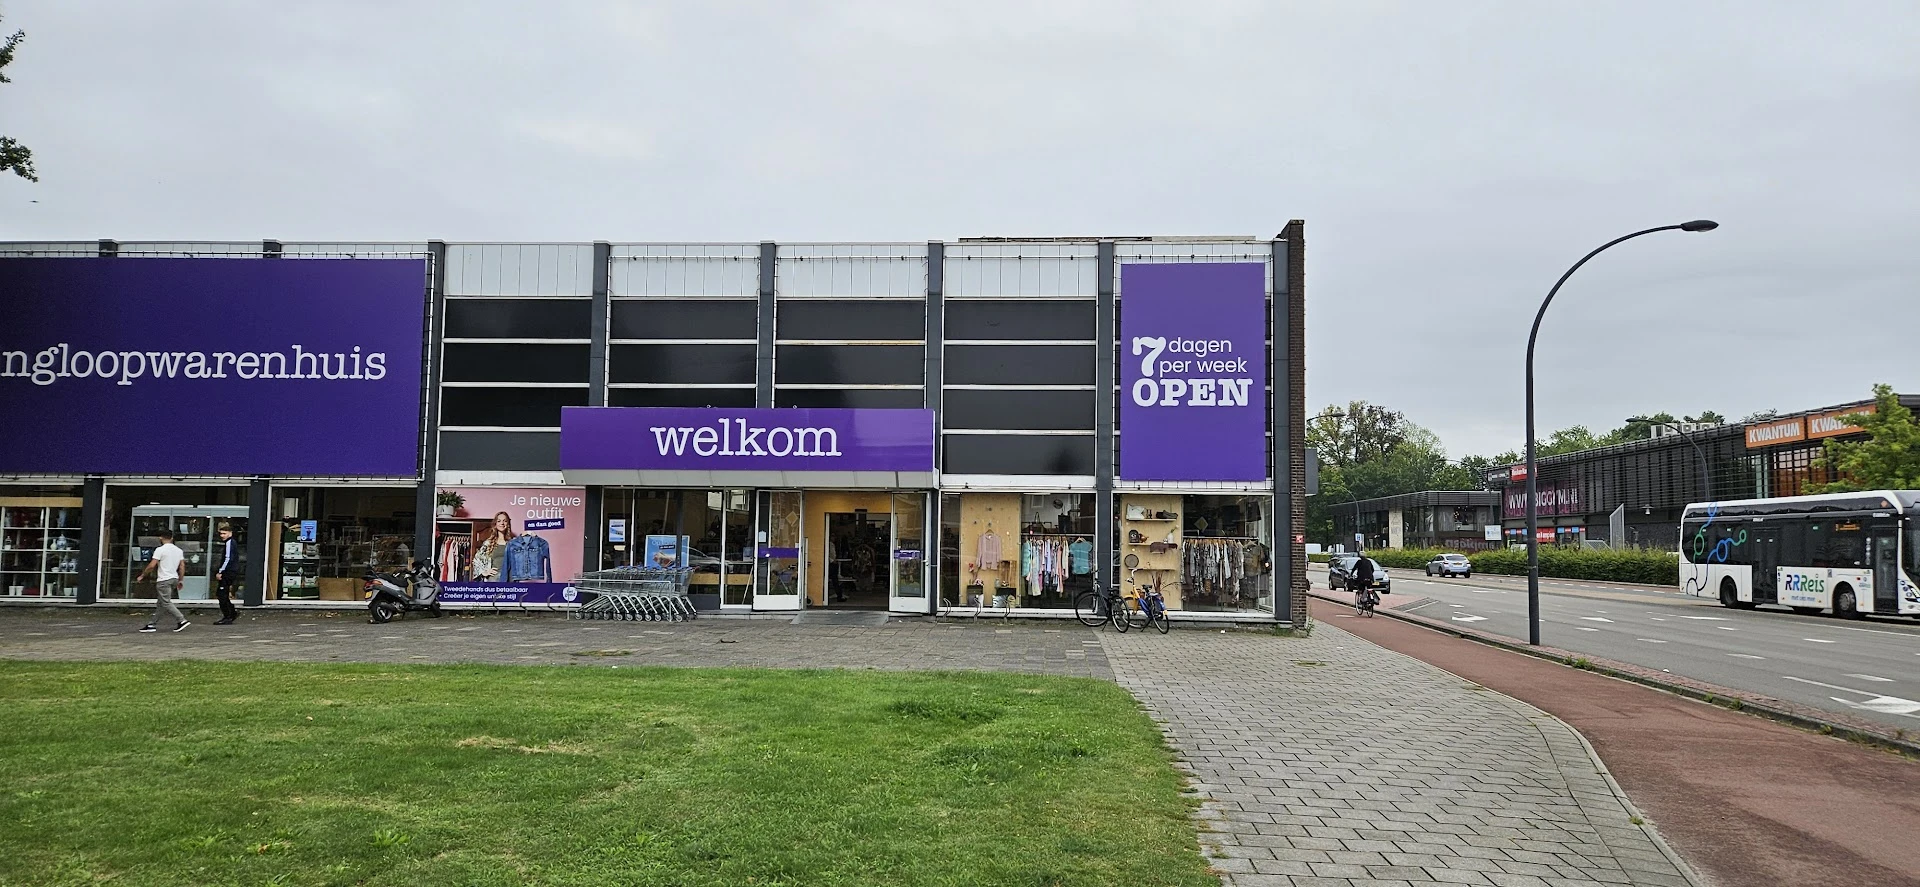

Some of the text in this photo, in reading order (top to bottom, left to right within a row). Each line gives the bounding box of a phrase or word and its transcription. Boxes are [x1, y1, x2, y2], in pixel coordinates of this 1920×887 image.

[0, 343, 387, 386] ngloopwarenhuis
[1132, 336, 1232, 378] 7 dagen
[1159, 356, 1248, 378] per week
[1132, 377, 1254, 407] OPEN
[649, 417, 843, 457] welkom
[1749, 422, 1800, 443] KWANTUM
[509, 493, 581, 507] Je nieuwe
[526, 506, 563, 519] outfit
[547, 520, 562, 528] goed
[443, 585, 484, 593] Tweedehands
[496, 586, 529, 594] betaalbaar
[1785, 574, 1825, 593] RRReis
[463, 592, 469, 600] je
[469, 592, 486, 601] eigen
[506, 593, 517, 601] stijl
